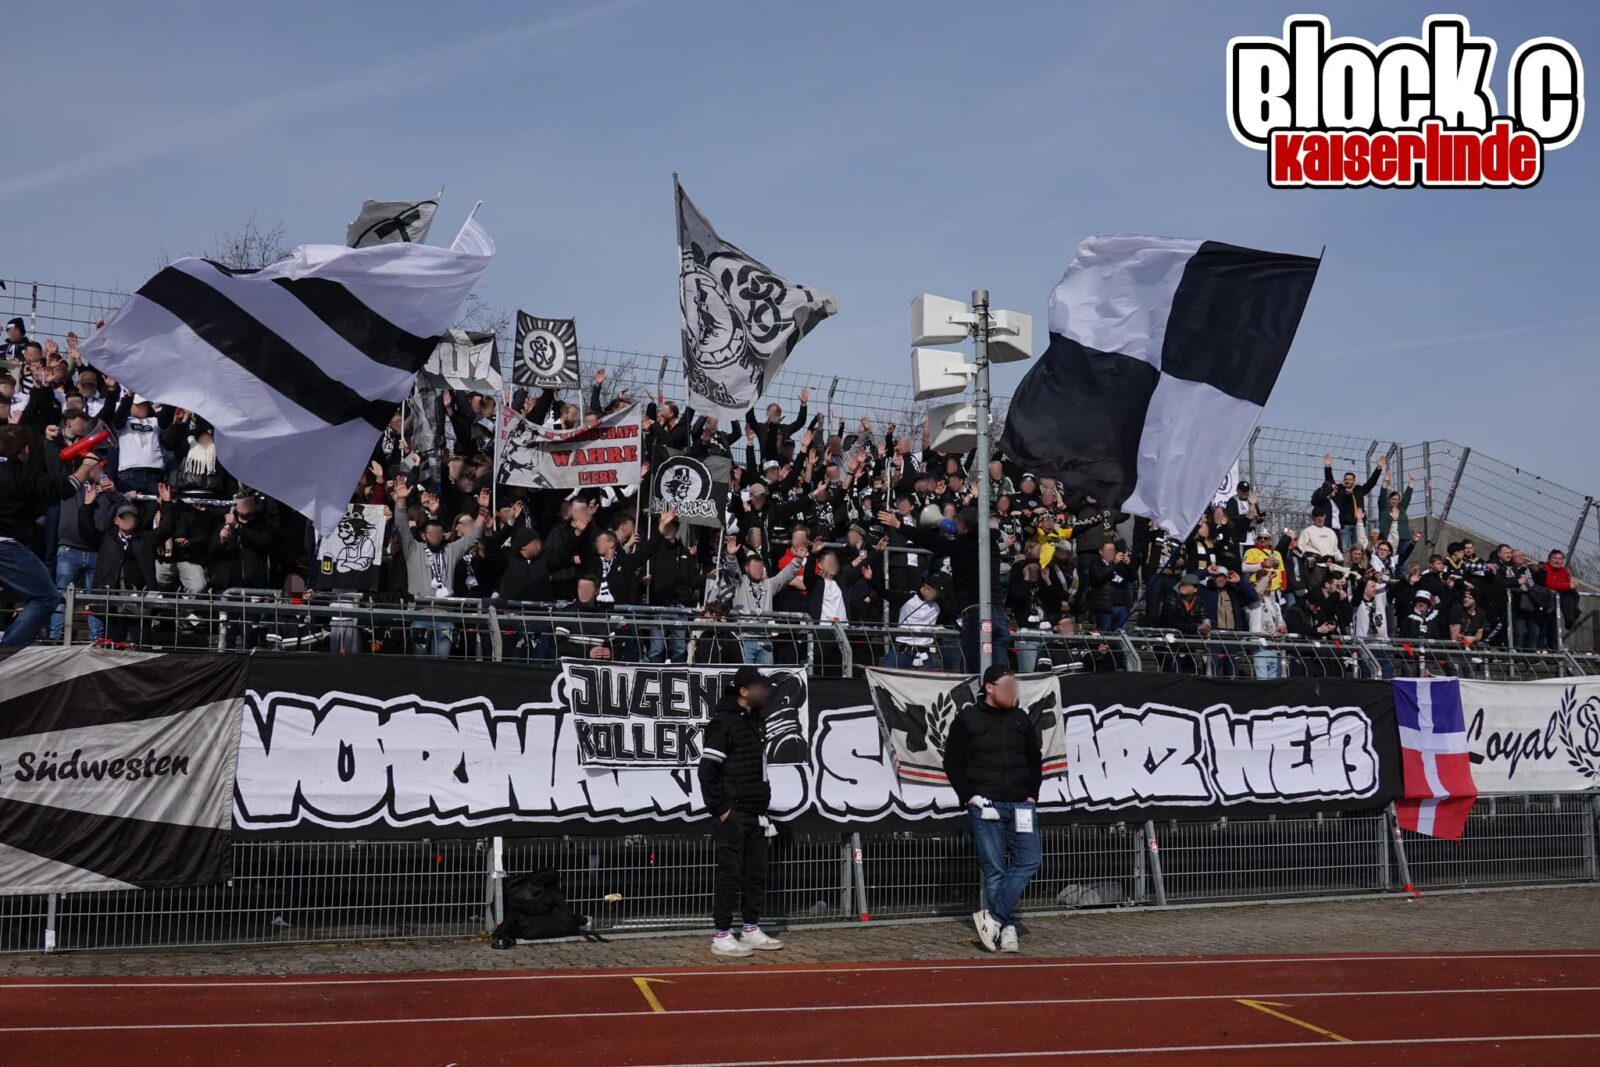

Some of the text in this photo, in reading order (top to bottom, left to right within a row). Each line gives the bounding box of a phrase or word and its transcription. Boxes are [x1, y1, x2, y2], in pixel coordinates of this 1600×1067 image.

[550, 444, 638, 468] WAHRE
[578, 469, 618, 486] LIEBE
[573, 718, 711, 764] KOLLEK
[1466, 707, 1558, 780] Loyal
[14, 748, 190, 783] Südwesten
